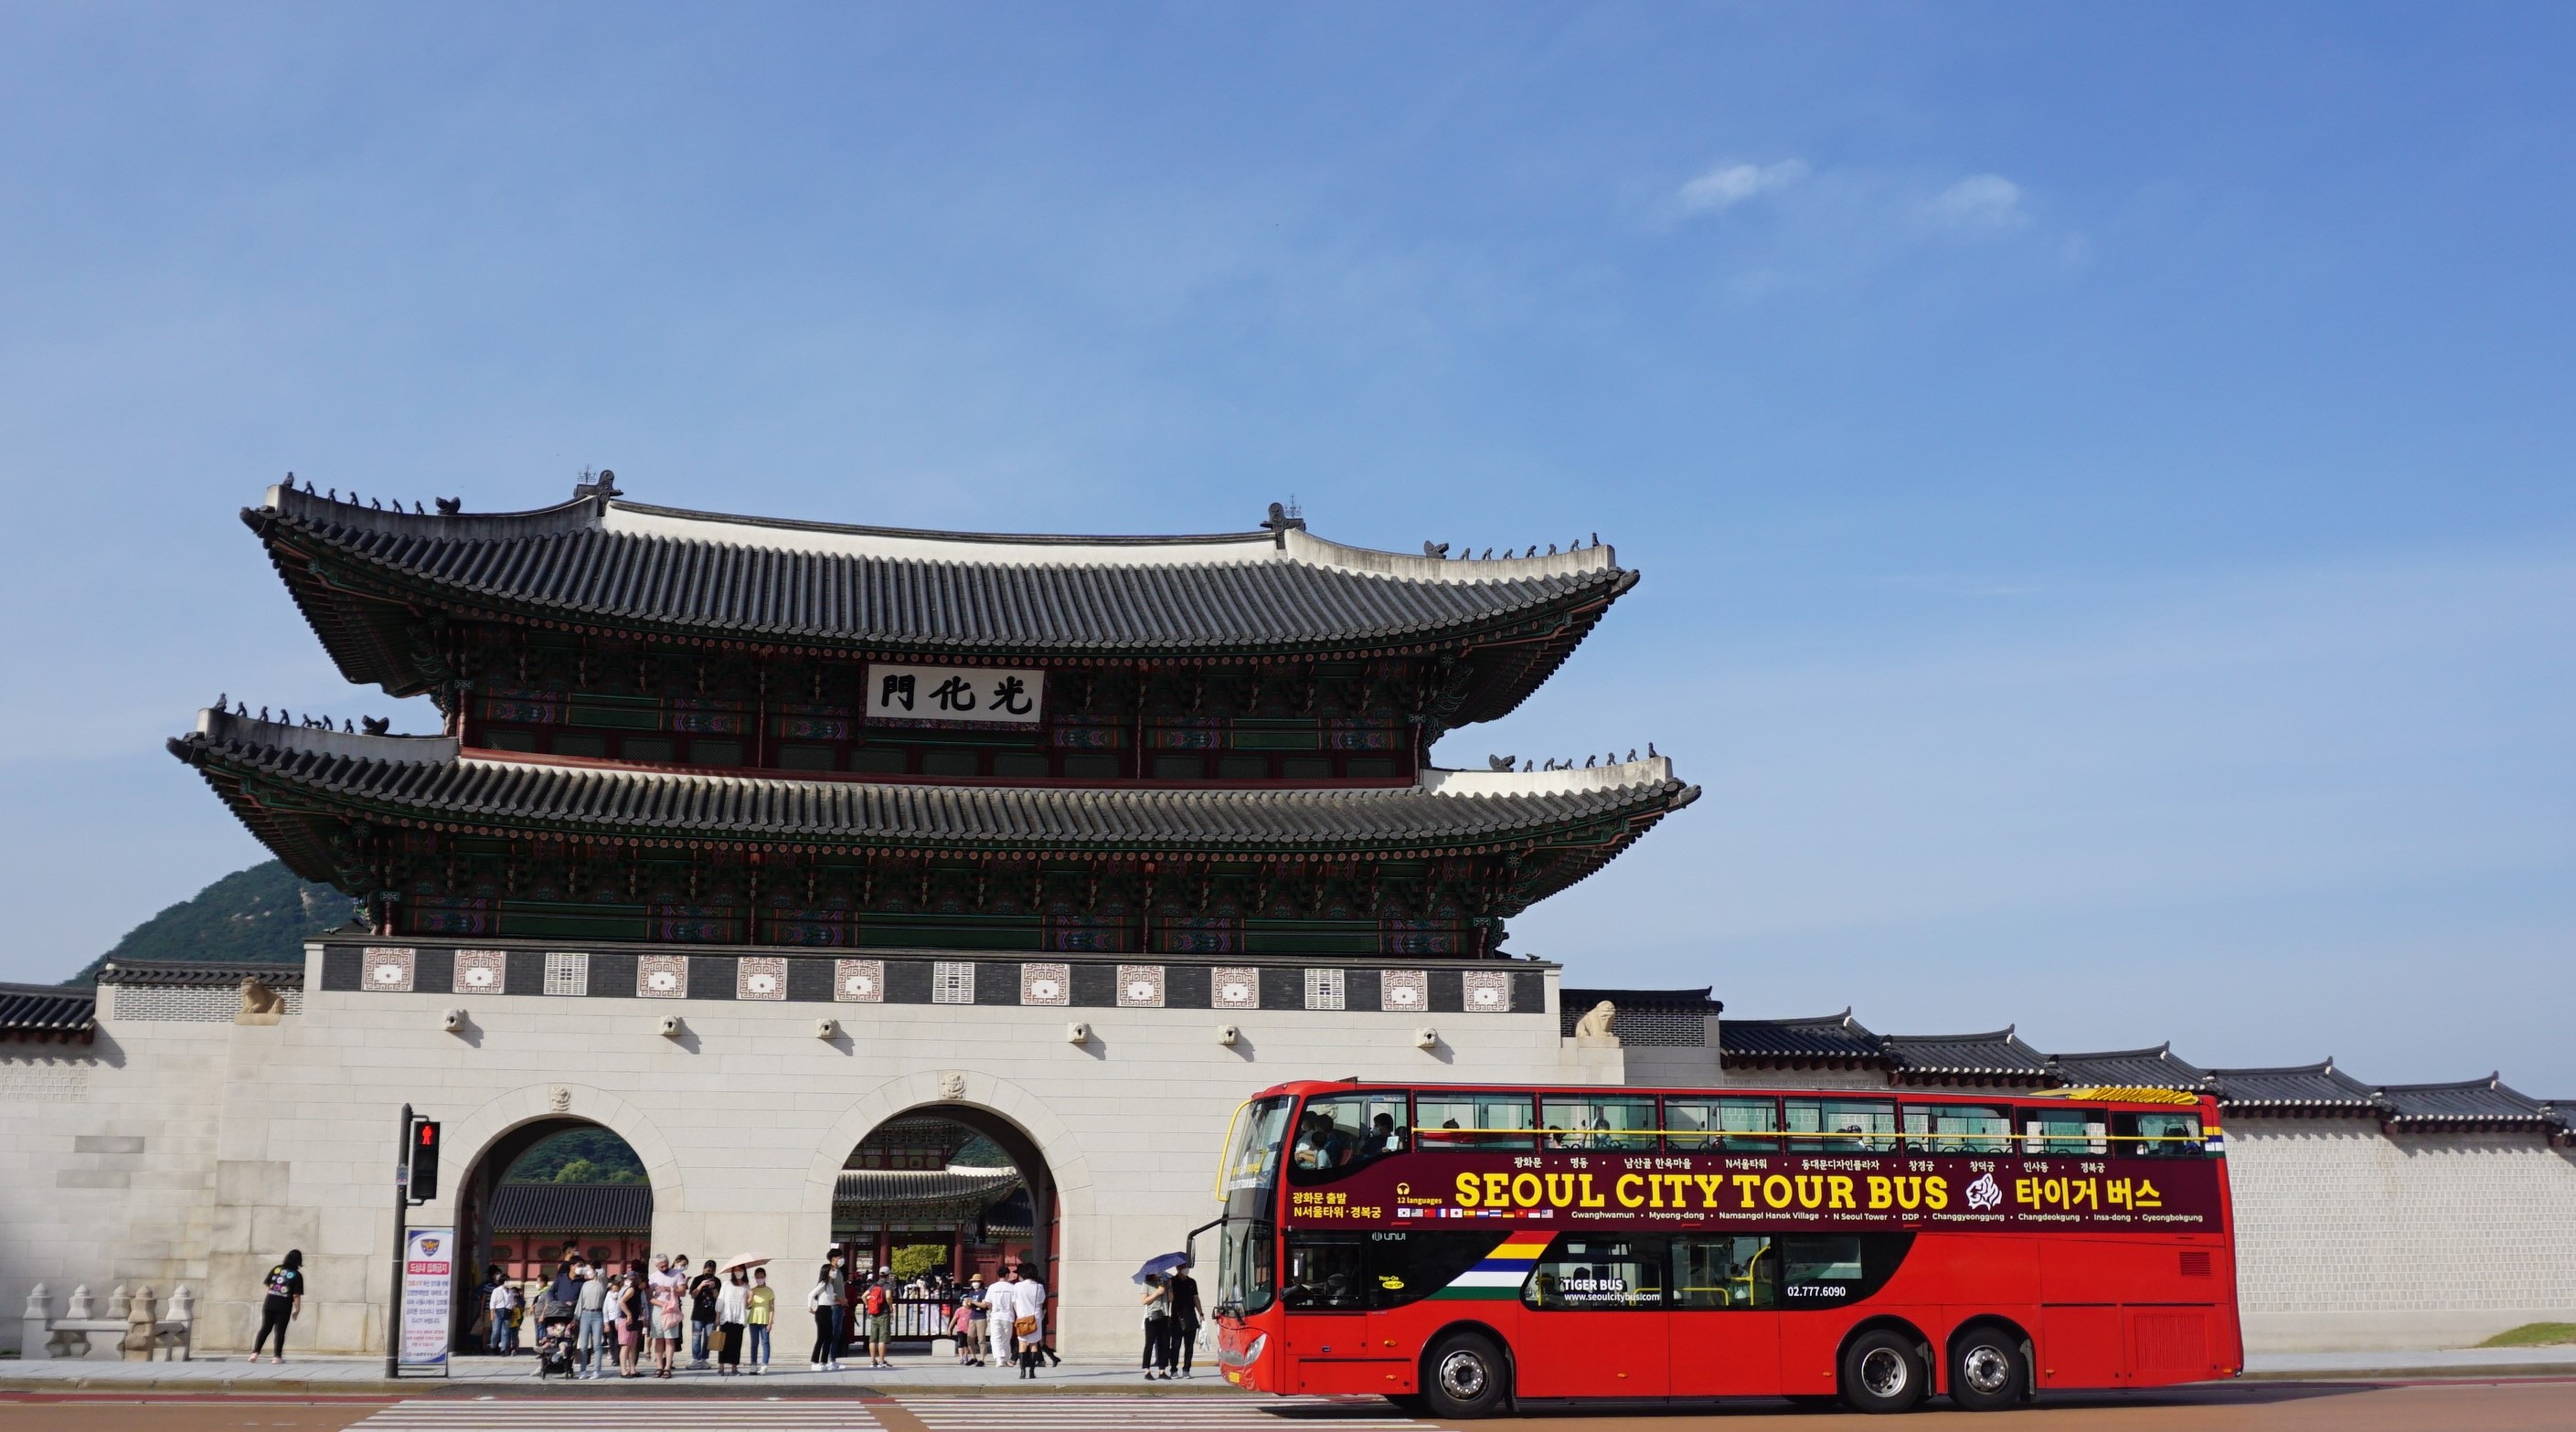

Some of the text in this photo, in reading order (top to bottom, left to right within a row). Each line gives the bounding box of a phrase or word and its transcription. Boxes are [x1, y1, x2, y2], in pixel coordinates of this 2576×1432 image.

[1513, 1156, 2106, 1173] 광화문 명동 남산골 한옥마을 N서울타워 동대문디자인플라자 창경궁 창덕궁 인사동 경복궁
[1455, 1172, 1948, 1210] SEOUL CITY TOUR BUS
[2015, 1176, 2162, 1211] 타이거 버스
[1292, 1192, 1347, 1204] 광화문 출발
[1397, 1196, 1442, 1206] 12 languages
[1570, 1210, 1635, 1220] Gwanghwamun
[1648, 1211, 1705, 1221] Myeong-dong
[1719, 1211, 1764, 1221] Namsangol
[1765, 1212, 1792, 1220] Hanok
[1792, 1211, 1820, 1221] Village
[1840, 1213, 1863, 1221] Seoul
[1864, 1213, 1889, 1221] Tower
[1901, 1213, 1920, 1221] DDP
[1932, 1212, 2006, 1222] Changgyeonggung
[2017, 1213, 2081, 1223] Changdeokgung
[2093, 1213, 2132, 1223] Insa-dong
[2142, 1214, 2203, 1223] Gyeongbokgung
[1563, 1278, 1623, 1290] TIGER BUS
[1564, 1292, 1660, 1303] www.seoulcitybus.com
[1787, 1286, 1847, 1298] 02.777.6090
